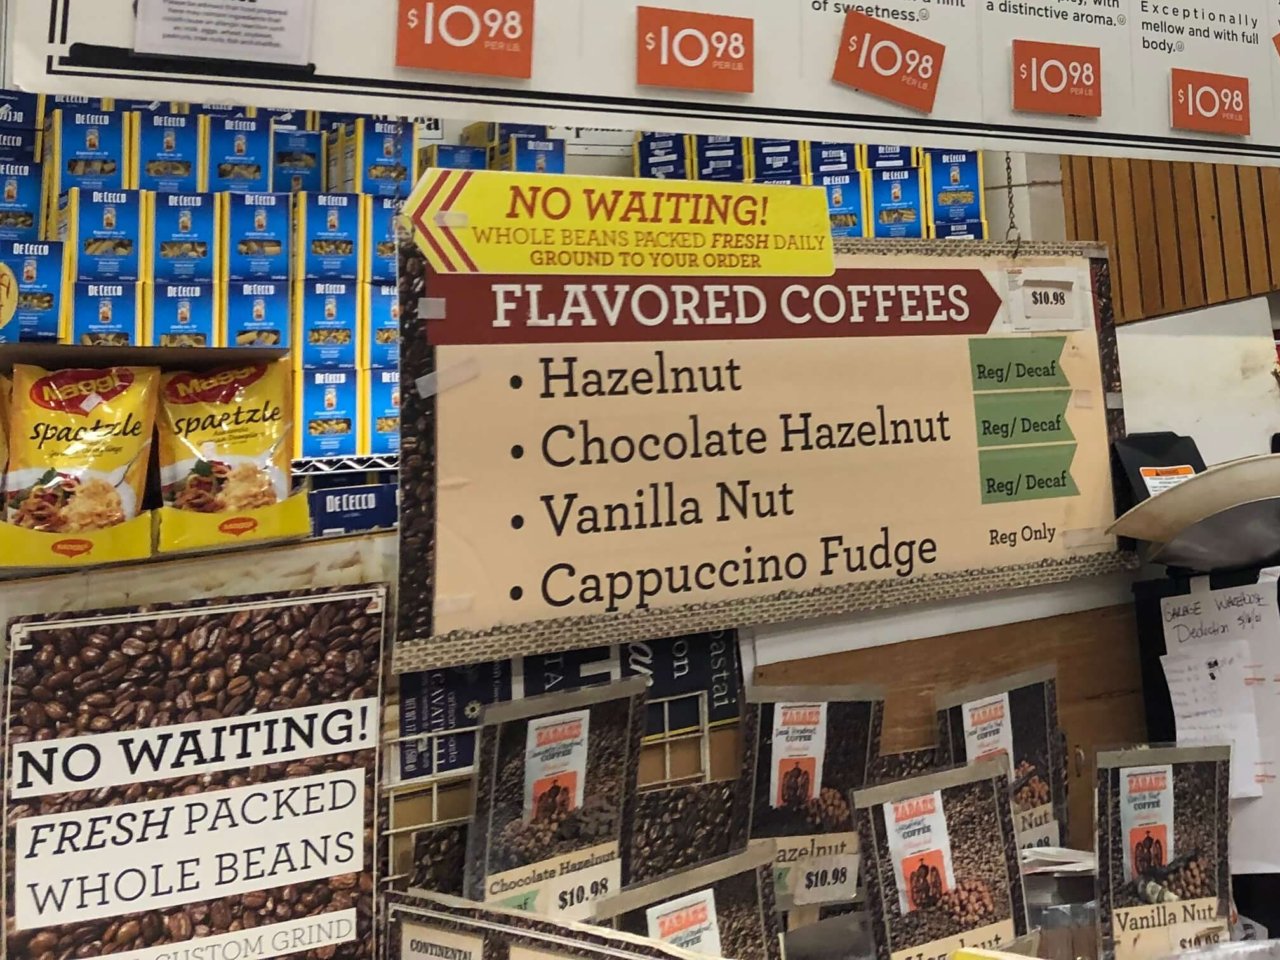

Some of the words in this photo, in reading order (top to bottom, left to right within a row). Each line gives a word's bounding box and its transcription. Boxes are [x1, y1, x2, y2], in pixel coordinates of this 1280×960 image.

[833, 4, 919, 22] sweetness.
[986, 2, 994, 11] a
[1072, 12, 1117, 27] aroma.
[1141, 0, 1258, 29] Exceptionally
[1141, 19, 1184, 37] mellow
[1188, 24, 1210, 39] and
[1211, 27, 1238, 42] with
[1241, 31, 1259, 44] full
[1142, 36, 1176, 54] body.
[505, 186, 571, 220] NO
[583, 190, 769, 227] WAITING!
[472, 227, 557, 245] WHOLE
[561, 229, 631, 247] BEANS
[635, 230, 706, 248] PACKED
[711, 233, 770, 249] FRESH
[774, 234, 826, 251] DAILY
[530, 250, 614, 266] GROUND
[619, 252, 645, 267] TO
[648, 252, 699, 268] YOUR
[703, 253, 762, 269] ORDER
[491, 282, 768, 328] FLAVORED
[779, 283, 971, 327] COFFEES
[1031, 288, 1066, 308] $10.98
[539, 351, 742, 399] Hazelnut
[976, 362, 1012, 383] Reg/
[1015, 359, 1057, 379] Decaf
[174, 400, 282, 437] spaetzle
[981, 417, 1016, 439] Reg/
[1019, 413, 1062, 435] Decaf
[541, 416, 768, 470] Chocolate
[779, 406, 951, 454] Hazelnut
[985, 475, 1021, 496] Reg/
[1025, 471, 1068, 492] Decaf
[541, 483, 704, 538] Vanilla
[715, 480, 795, 523] Nut
[989, 527, 1016, 548] Reg
[1021, 523, 1057, 547] Only
[541, 545, 807, 614] Cappuccino
[819, 528, 938, 582] Fudge
[17, 744, 102, 791] NO
[118, 705, 369, 775] WAITING!
[24, 807, 172, 859] FRESH
[184, 779, 358, 836] PACKED
[1021, 810, 1050, 832] Nut
[27, 866, 201, 916] WHOLE
[215, 831, 355, 885] BEANS
[489, 863, 557, 896] Chocolate
[559, 849, 615, 874] Hazelnut
[804, 867, 847, 890] $10.98
[558, 877, 610, 911] $10.98
[1116, 908, 1177, 932] Vanilla
[1182, 903, 1214, 923] Nut
[272, 917, 354, 952] GRIND
